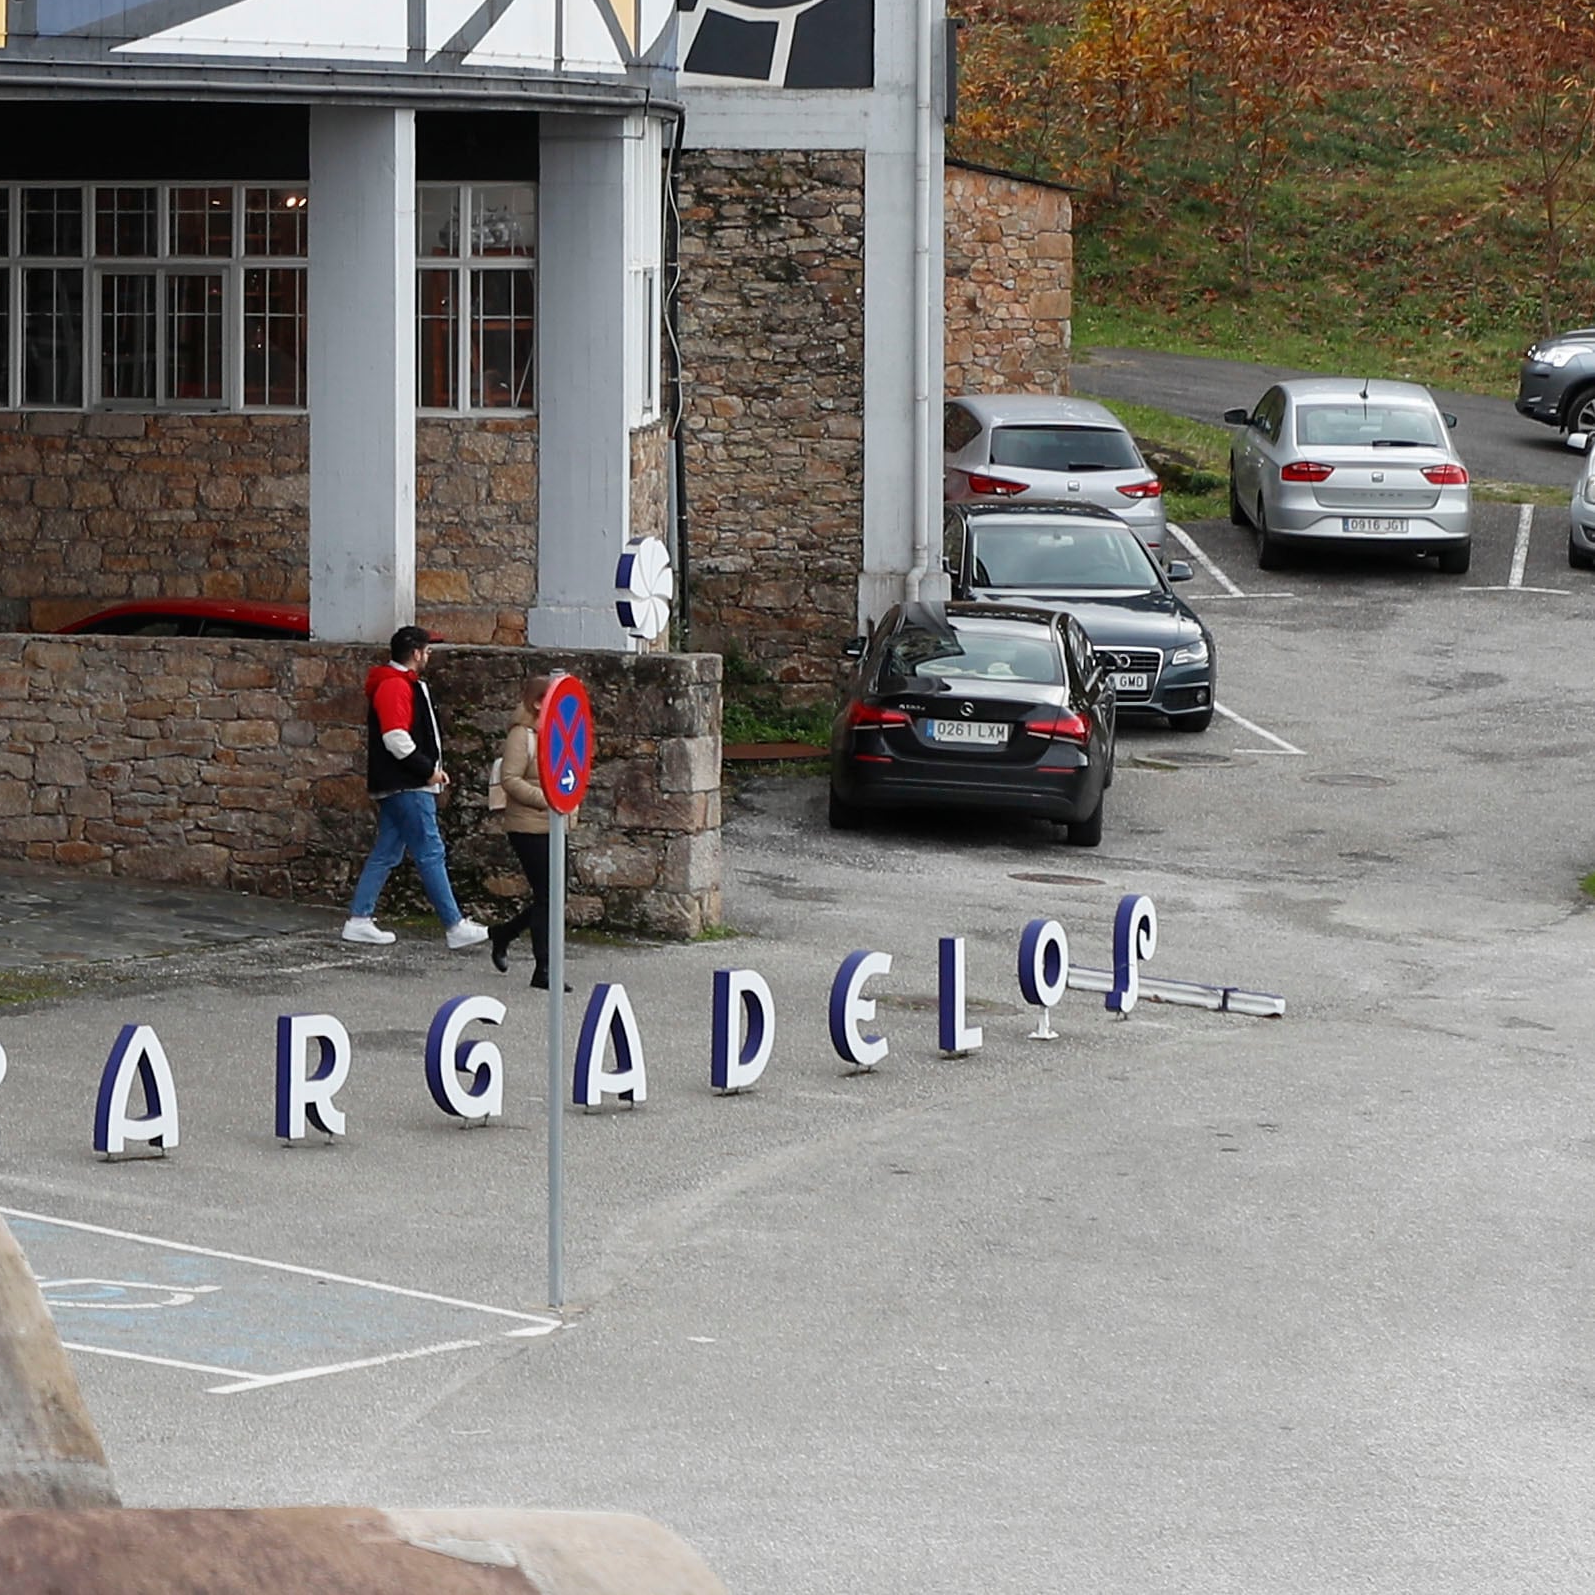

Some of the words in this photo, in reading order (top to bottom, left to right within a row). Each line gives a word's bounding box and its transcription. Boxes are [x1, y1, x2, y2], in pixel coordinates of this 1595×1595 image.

[1350, 518, 1381, 531] 0916
[1119, 675, 1144, 688] GMD
[937, 722, 972, 737] 0261
[977, 724, 1006, 739] LXM
